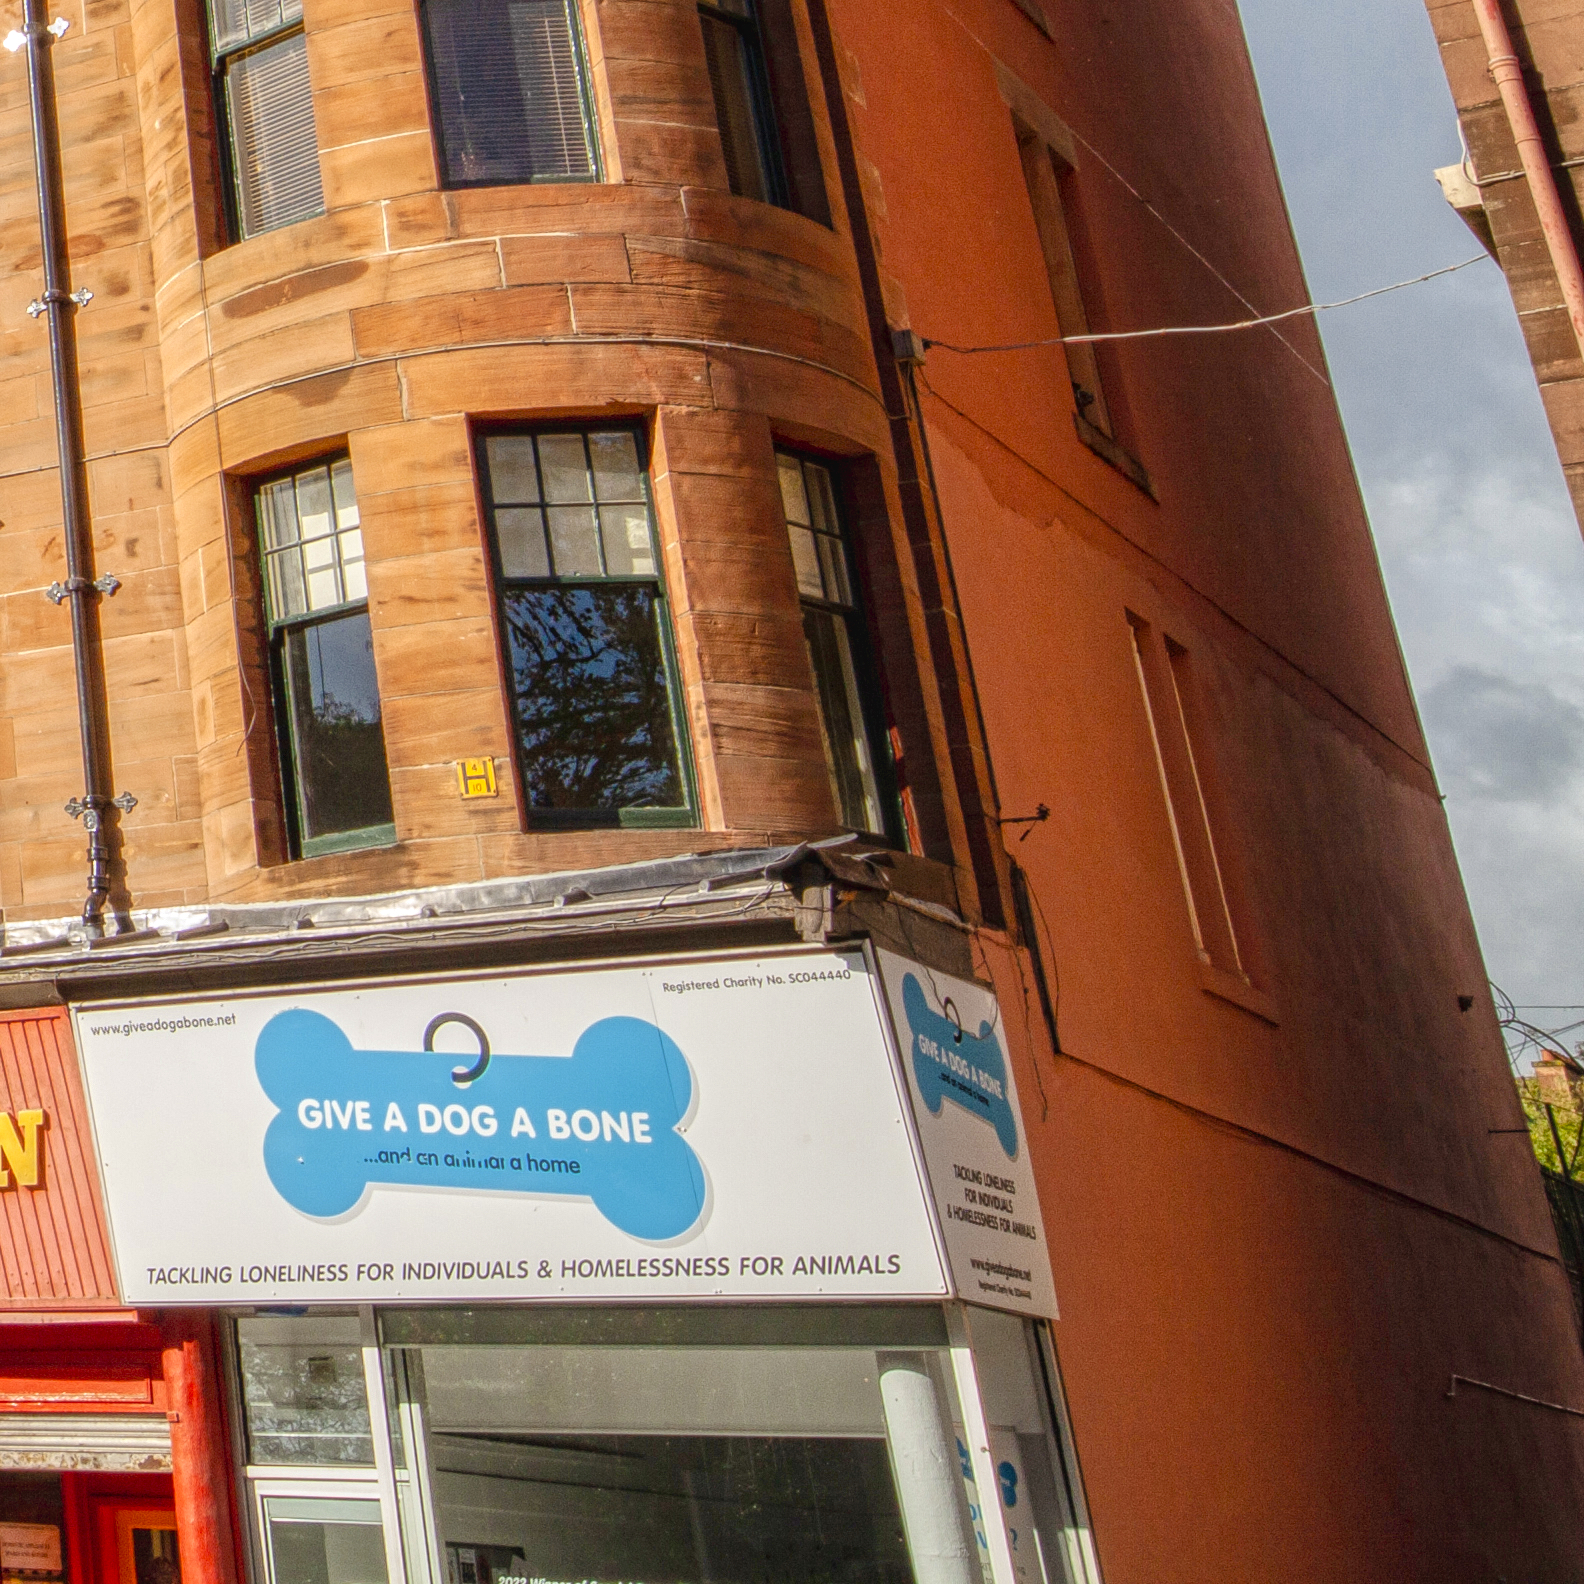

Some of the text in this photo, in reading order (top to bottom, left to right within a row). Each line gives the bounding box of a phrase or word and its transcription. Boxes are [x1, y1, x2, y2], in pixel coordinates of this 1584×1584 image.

[662, 969, 852, 994] Registered Charity No. SC044440
[90, 1012, 237, 1037] www.giveadogabone.net
[918, 1033, 1004, 1101] GIVE DOG BONE
[297, 1098, 653, 1144] GIVE A DOG A BONE
[510, 1156, 523, 1171] a
[526, 1152, 582, 1174] home
[952, 1163, 1016, 1195] TACKLING LONELINESS
[964, 1187, 1014, 1215] FOR INDIVIDUALS
[953, 1204, 1037, 1241] HOMELESSNESS FOR ANIMALS
[146, 1253, 902, 1285] TACKLING LONELINESS FOR INDIVIDUALS & HOMELESSNESS FOR ANIMALS
